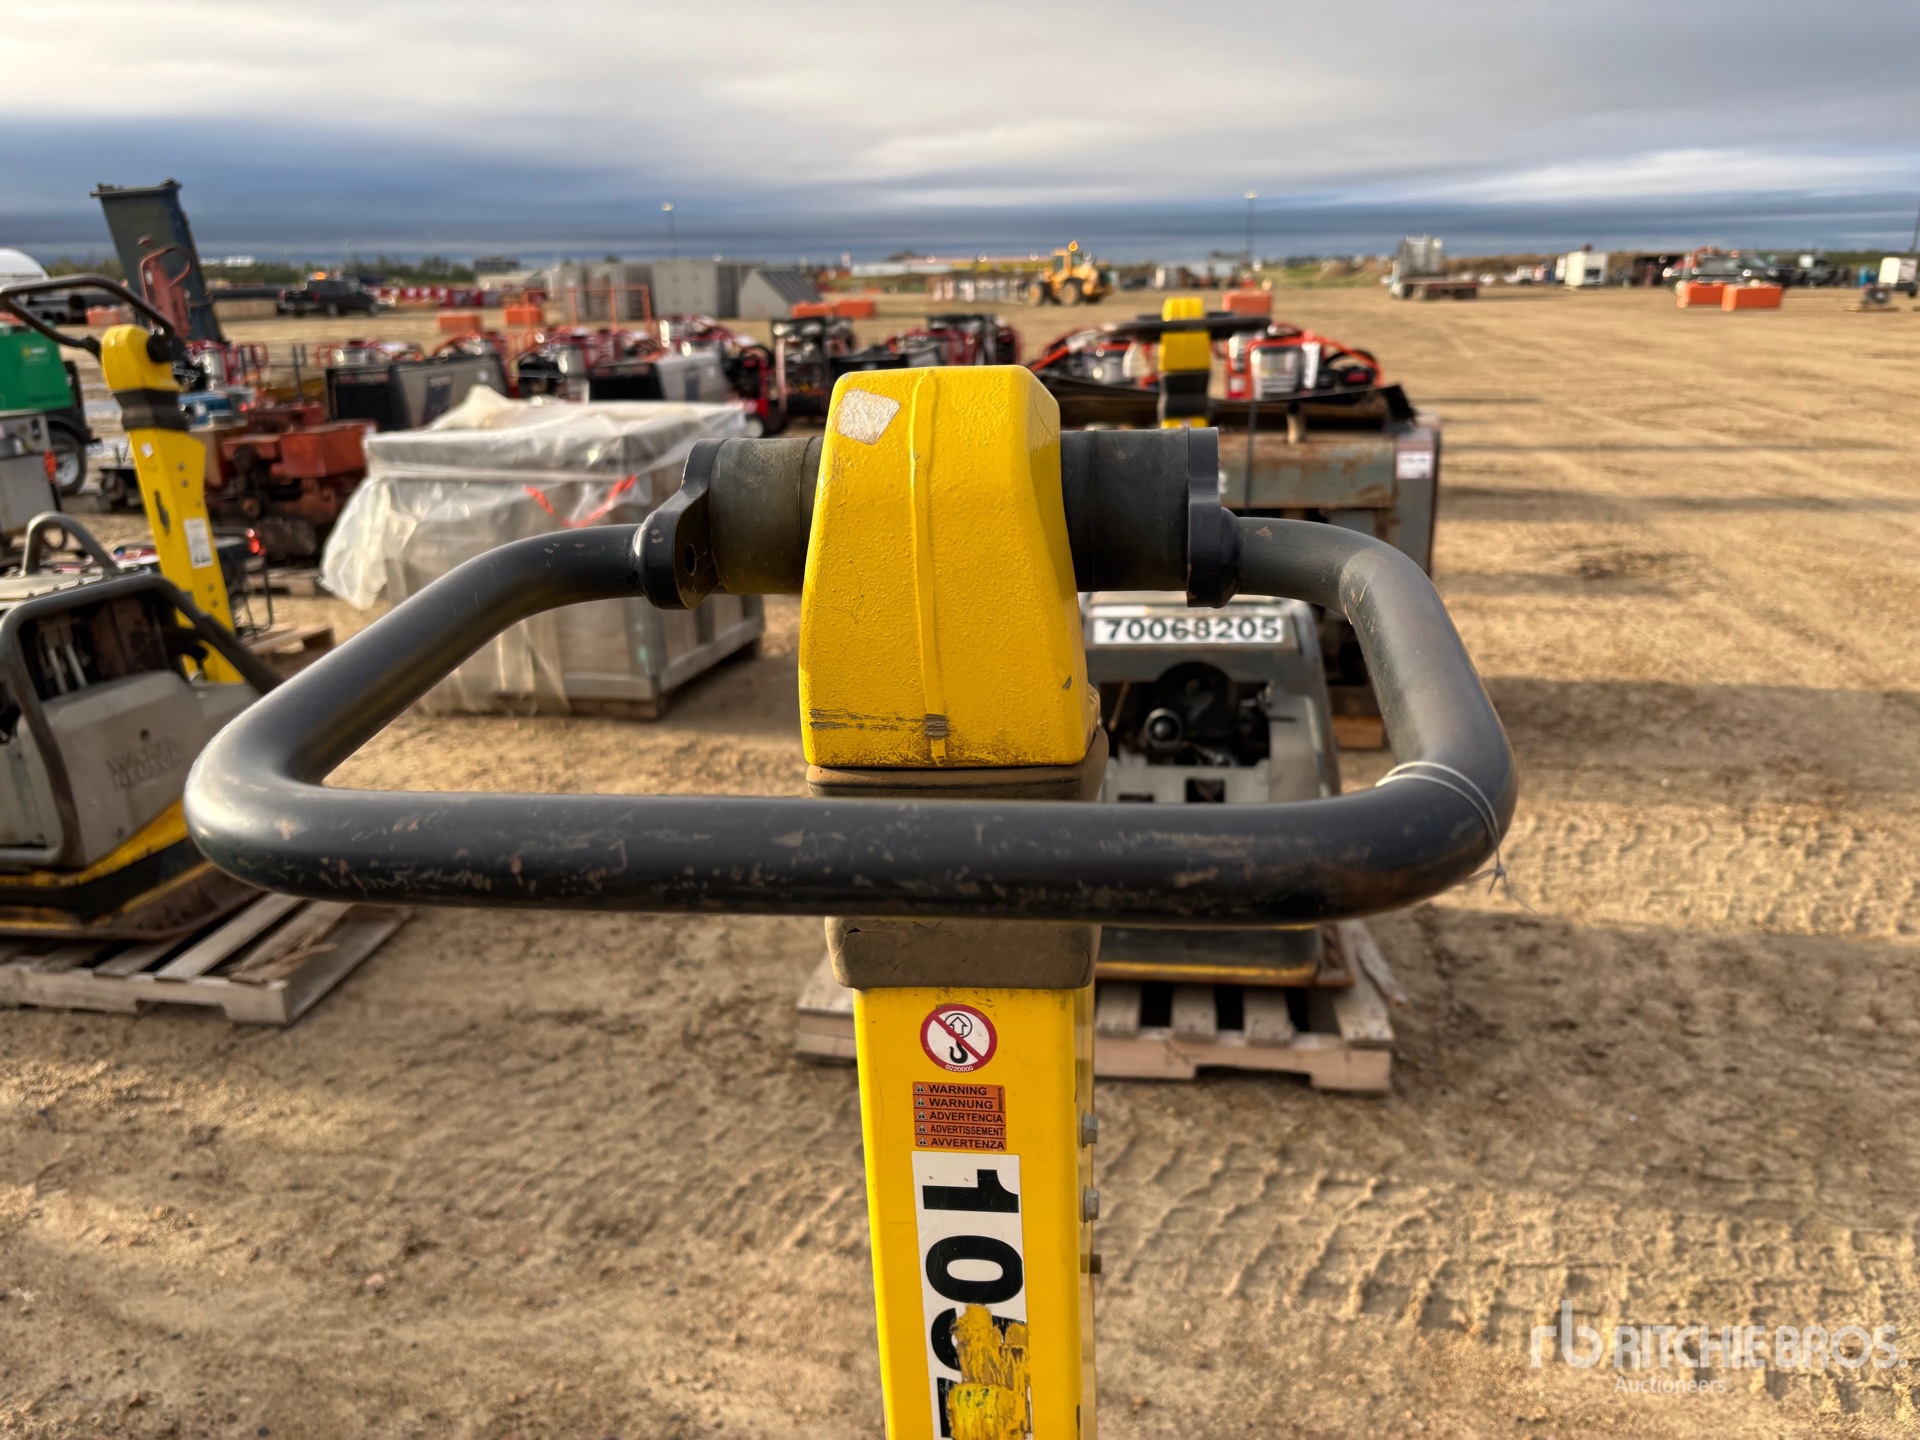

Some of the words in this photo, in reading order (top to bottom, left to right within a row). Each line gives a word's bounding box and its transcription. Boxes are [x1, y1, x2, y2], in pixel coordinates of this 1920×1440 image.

[1106, 617, 1279, 641] 70068205
[928, 1084, 987, 1096] WARNING
[929, 1098, 993, 1109] WARNUNG
[929, 1111, 1003, 1123] ADVERTENCIA
[930, 1124, 1005, 1136] ADVERTISSEMENT
[931, 1137, 1005, 1150] AVVERTENZA
